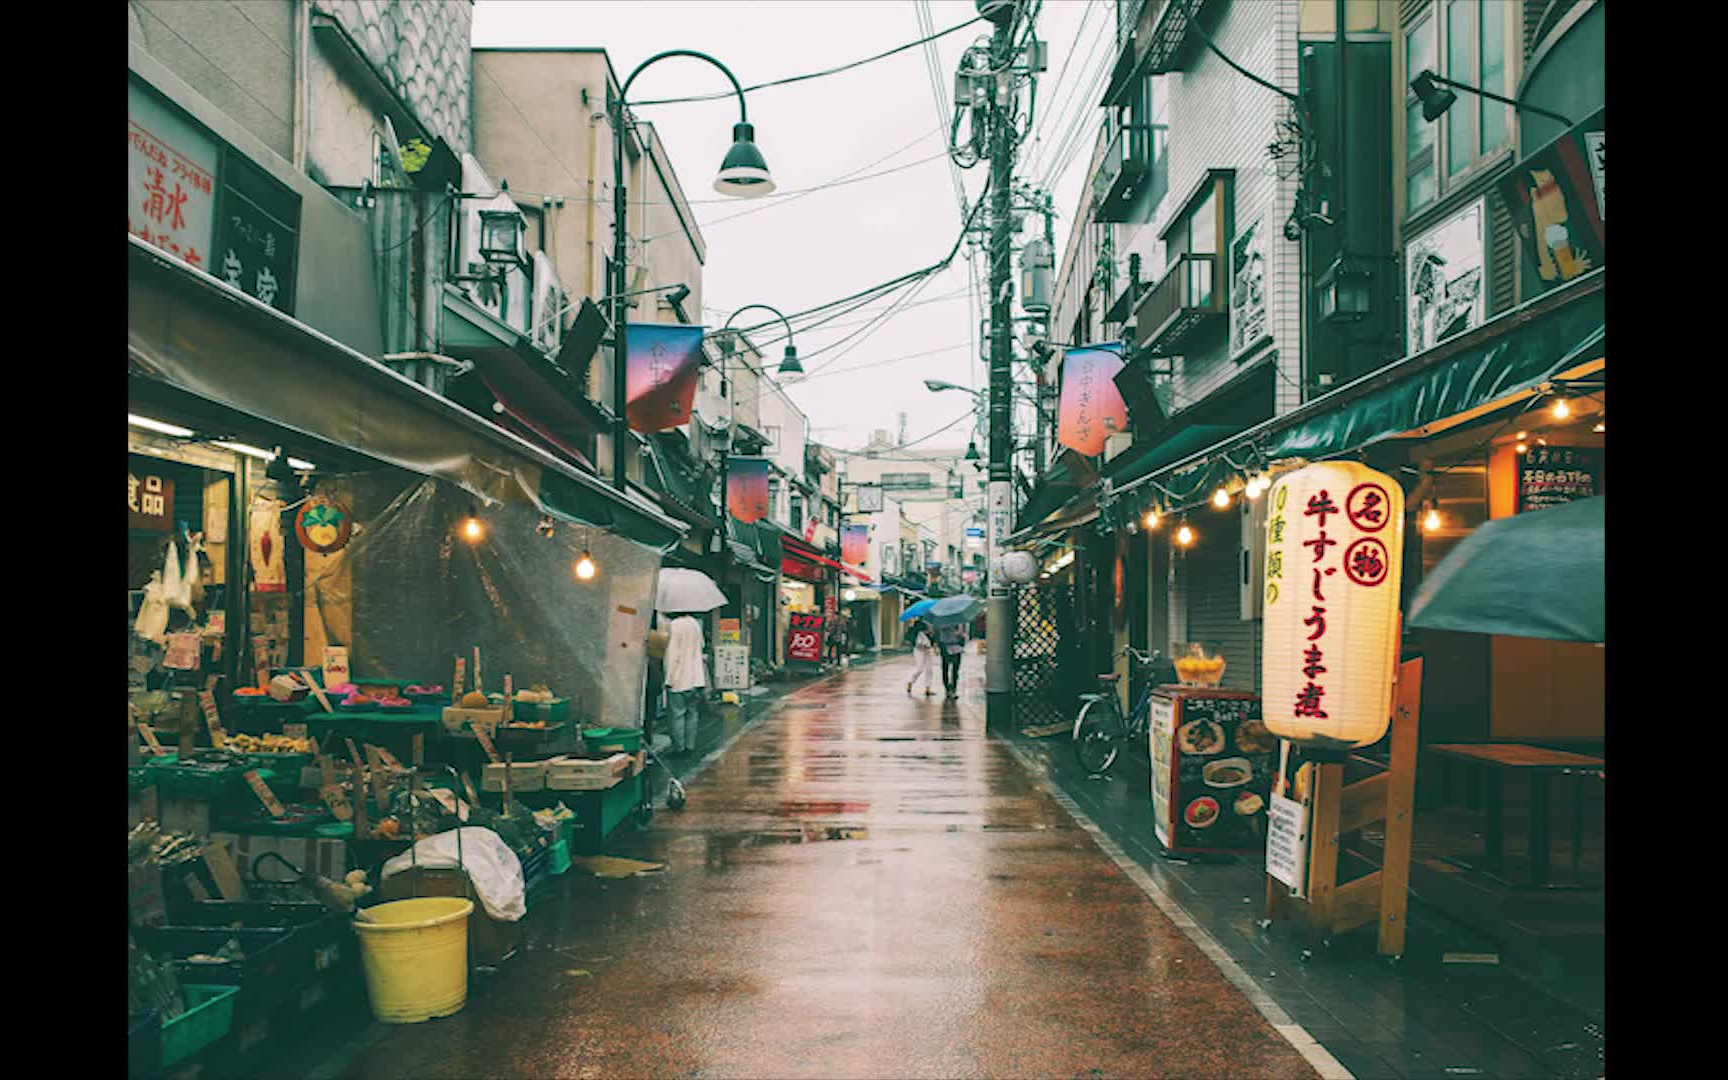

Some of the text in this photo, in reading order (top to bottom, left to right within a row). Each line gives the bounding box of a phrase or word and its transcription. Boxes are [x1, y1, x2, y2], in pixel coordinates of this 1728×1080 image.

[143, 165, 188, 231] 清水
[1350, 488, 1385, 581] 名物
[1294, 489, 1340, 719] 牛すじうま煮
